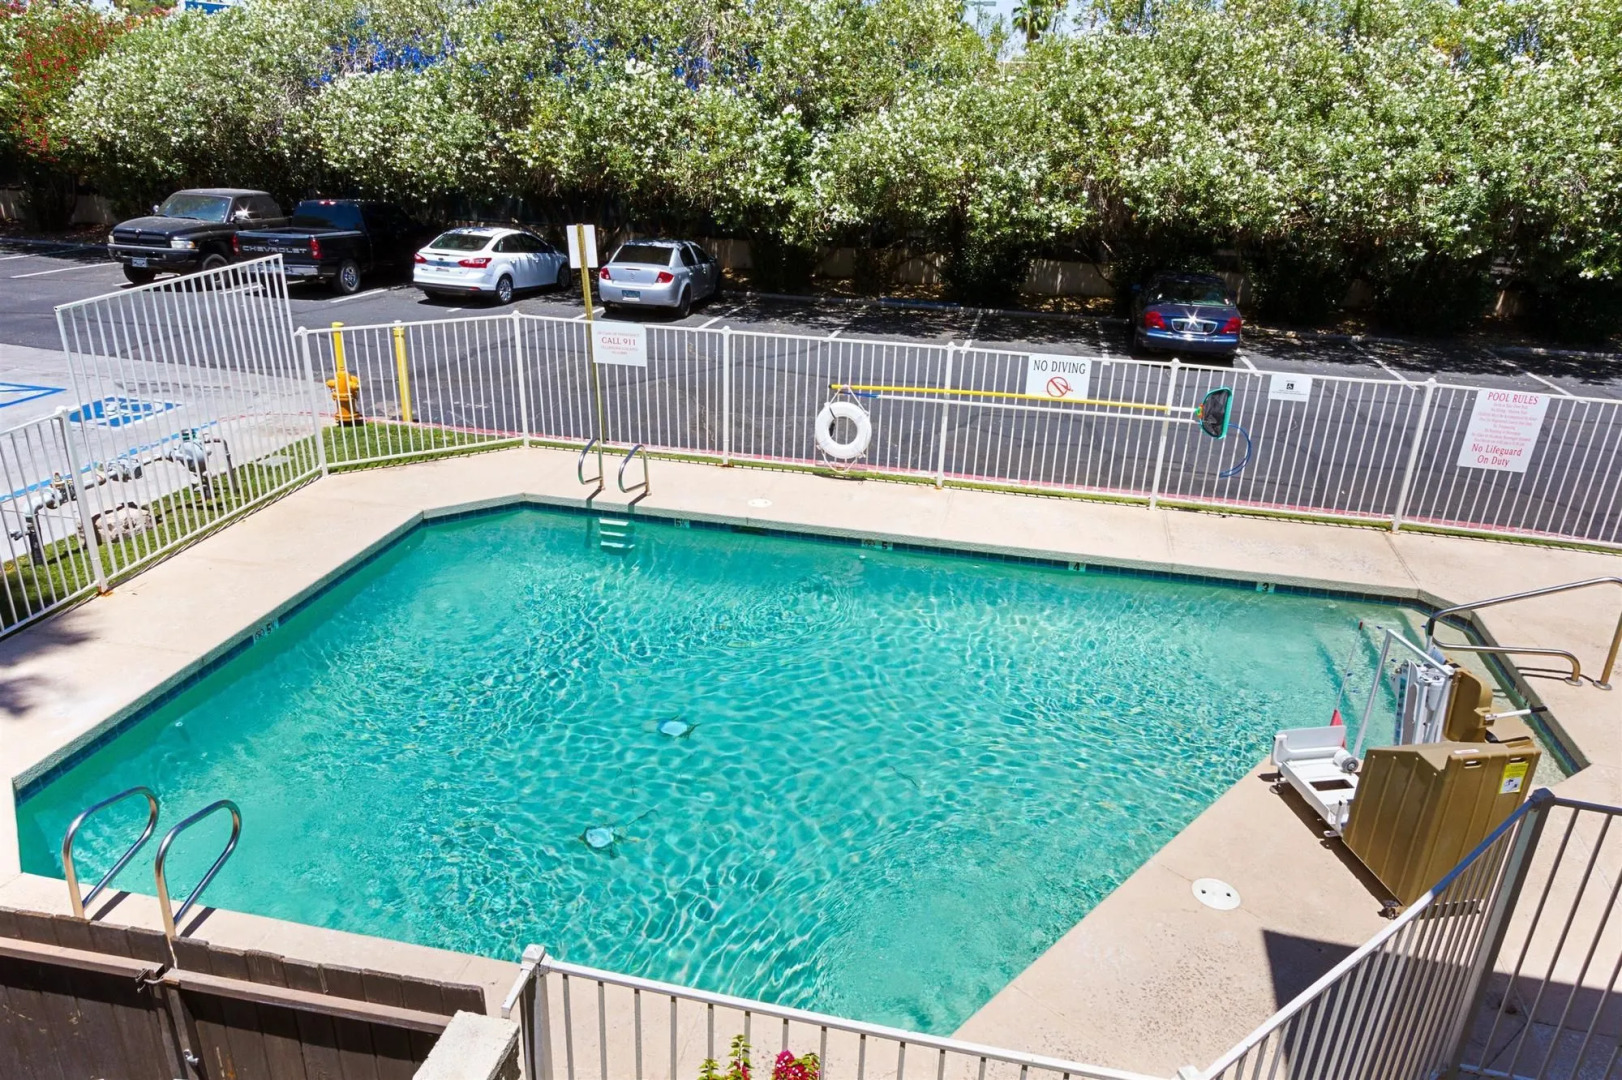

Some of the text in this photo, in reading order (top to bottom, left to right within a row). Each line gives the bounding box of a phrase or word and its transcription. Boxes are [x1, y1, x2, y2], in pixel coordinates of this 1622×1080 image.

[242, 245, 307, 254] CHEVROLET
[601, 336, 636, 346] CALL 911
[1033, 359, 1086, 375] NO DIVING
[1487, 391, 1539, 405] POOL RULES
[1471, 443, 1522, 457] No Lifeguard
[1477, 454, 1510, 467] On Duty
